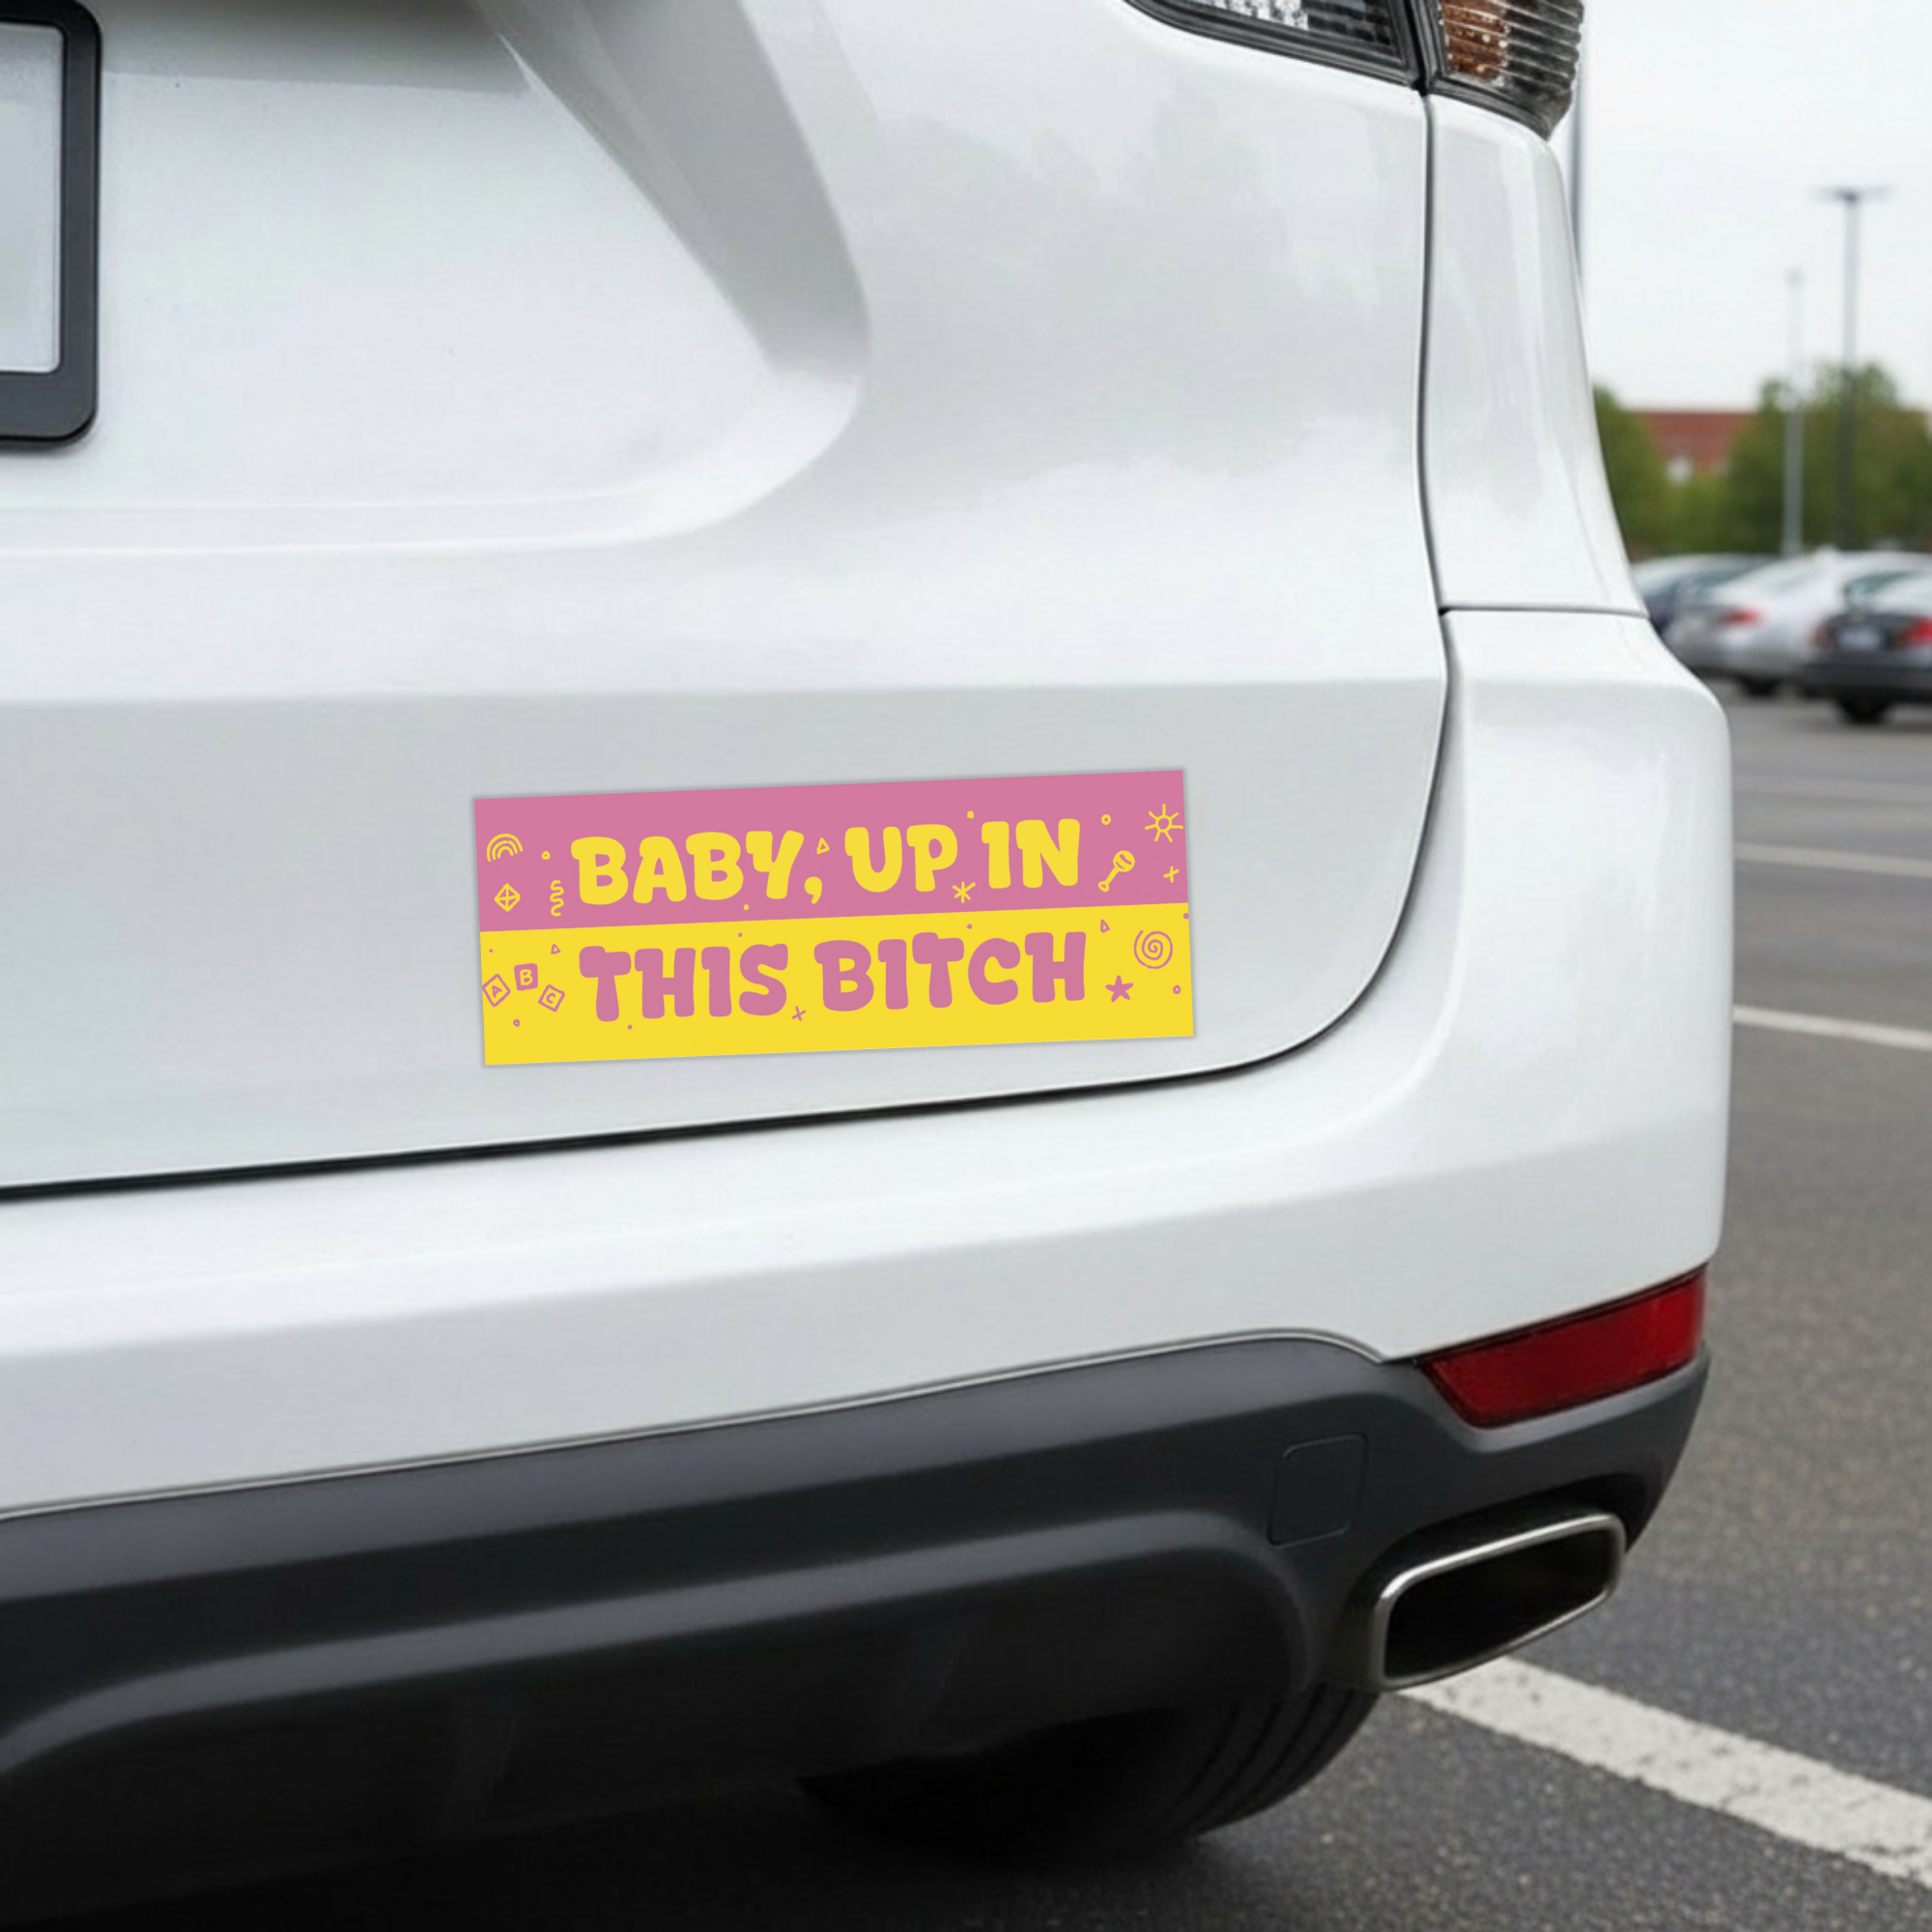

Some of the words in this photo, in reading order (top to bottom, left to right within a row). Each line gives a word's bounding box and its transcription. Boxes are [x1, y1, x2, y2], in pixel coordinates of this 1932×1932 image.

[570, 829, 823, 905] BABY,
[844, 823, 958, 893] UP
[980, 818, 1081, 889] IN
[579, 943, 789, 1022] THIS
[813, 931, 1087, 1012] BITCH
